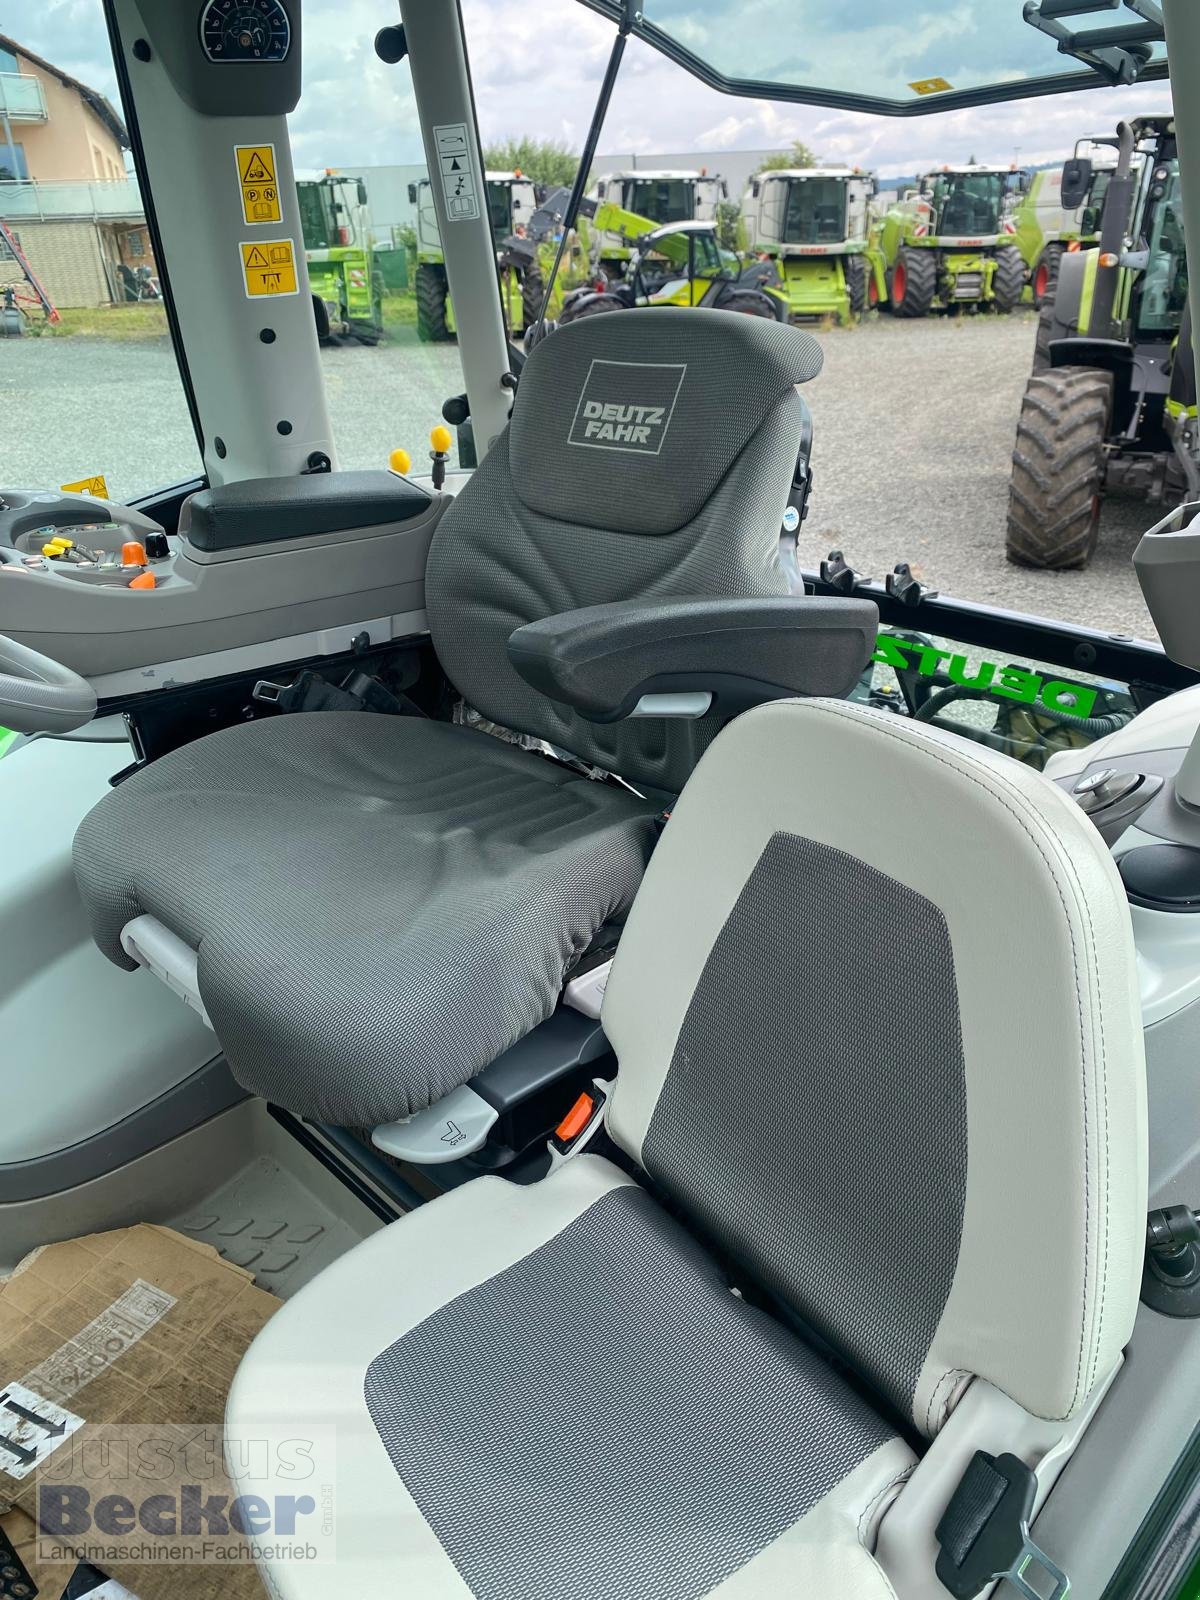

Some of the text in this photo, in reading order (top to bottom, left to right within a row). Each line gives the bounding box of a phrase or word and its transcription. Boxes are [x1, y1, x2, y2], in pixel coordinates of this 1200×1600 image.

[583, 401, 666, 425] DEUTZ
[584, 420, 651, 443] FAHR
[60, 1328, 136, 1388] 100%
